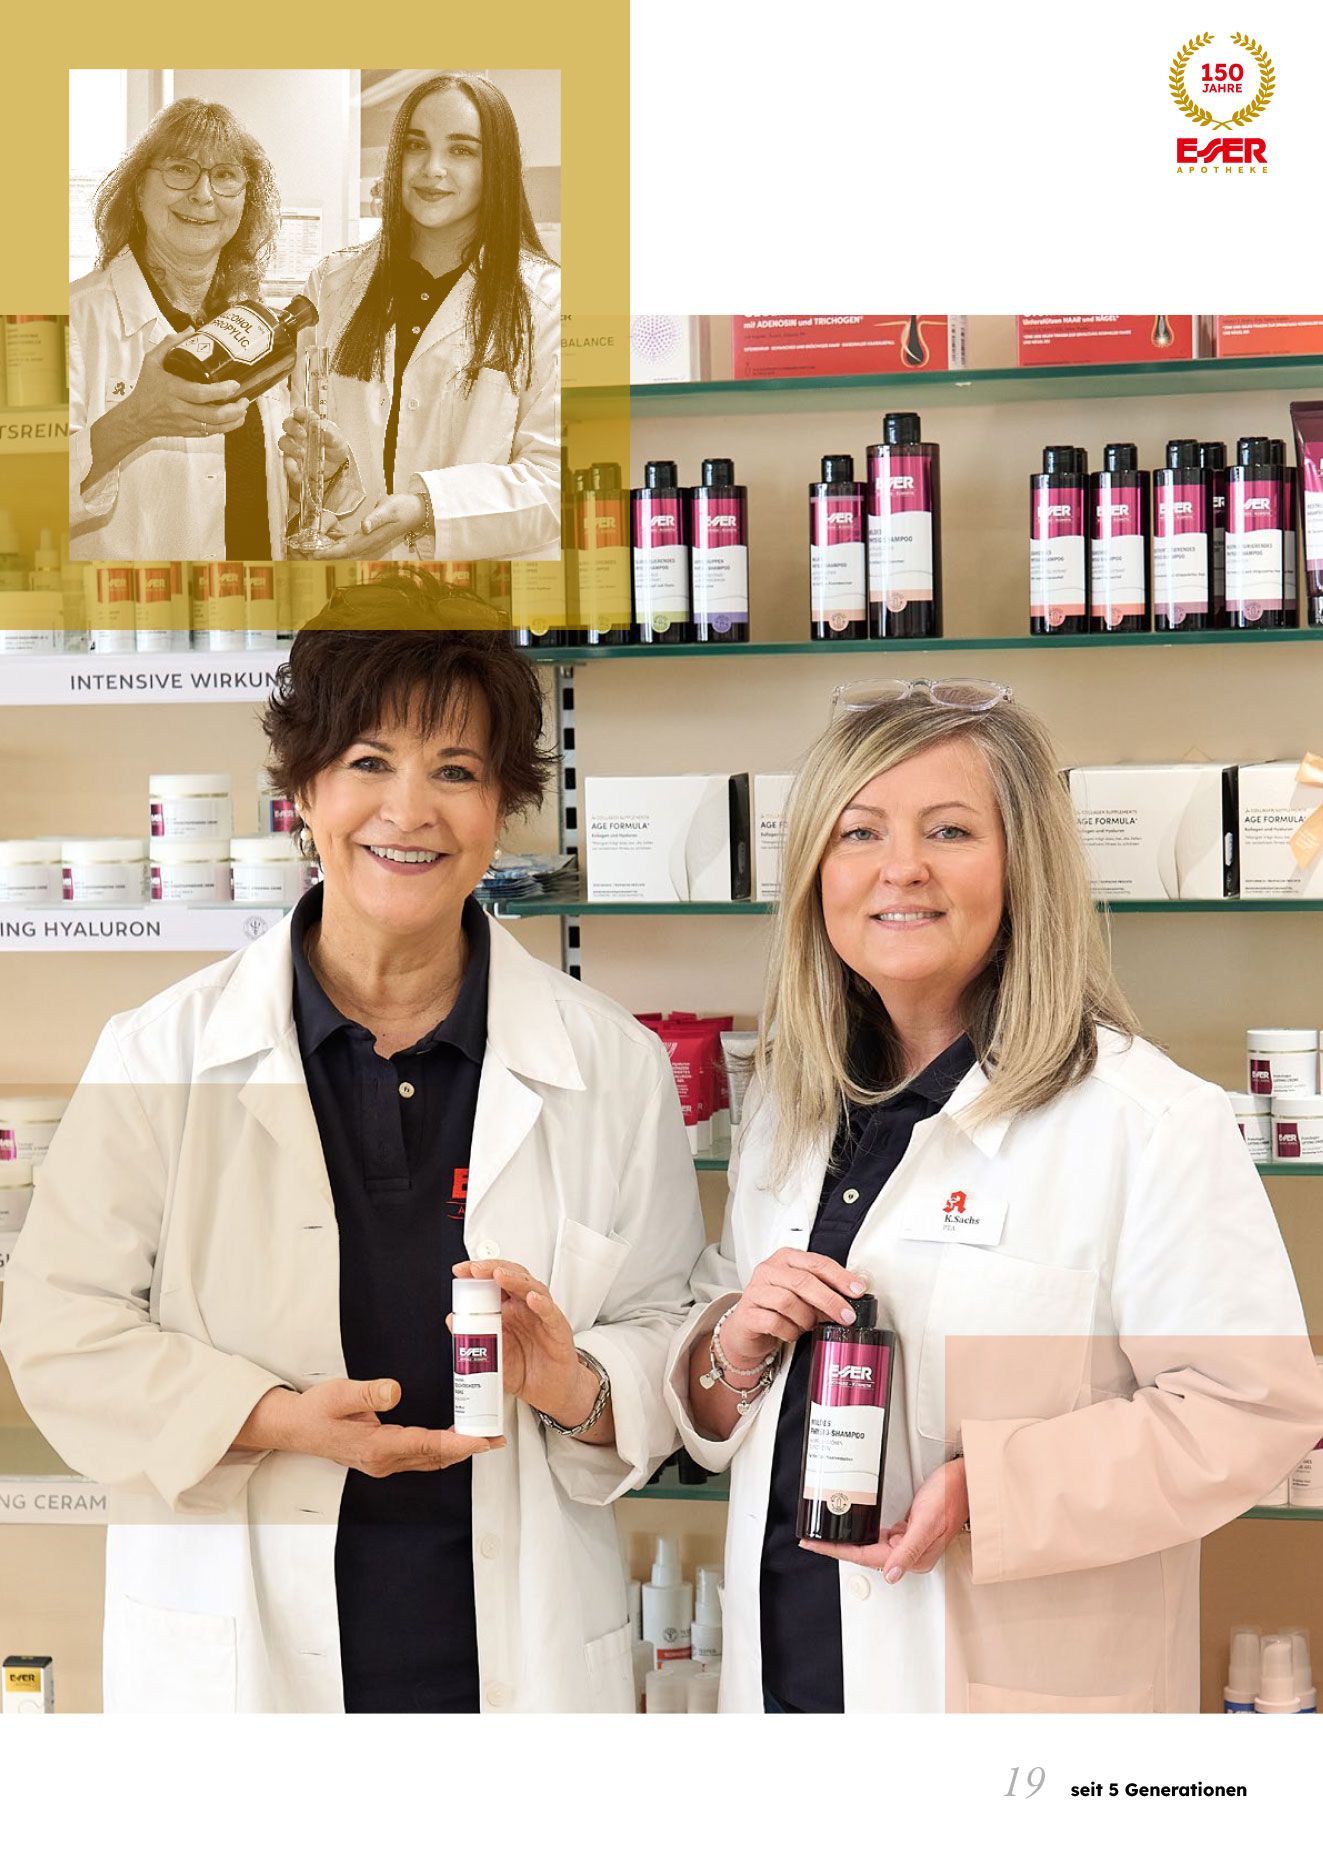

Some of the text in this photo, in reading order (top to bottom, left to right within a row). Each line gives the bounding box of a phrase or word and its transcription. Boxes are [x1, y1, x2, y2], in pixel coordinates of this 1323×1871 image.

[743, 321, 756, 329] mit
[756, 319, 797, 329] ADENOSIN
[798, 318, 813, 327] und
[1063, 316, 1082, 324] HAAR
[560, 336, 615, 348] BALANCE
[70, 673, 183, 690] INTENSIVE
[591, 822, 607, 830] AGE
[760, 821, 777, 829] AGE
[44, 921, 161, 938] HYALURON
[34, 1494, 107, 1511] CERAM
